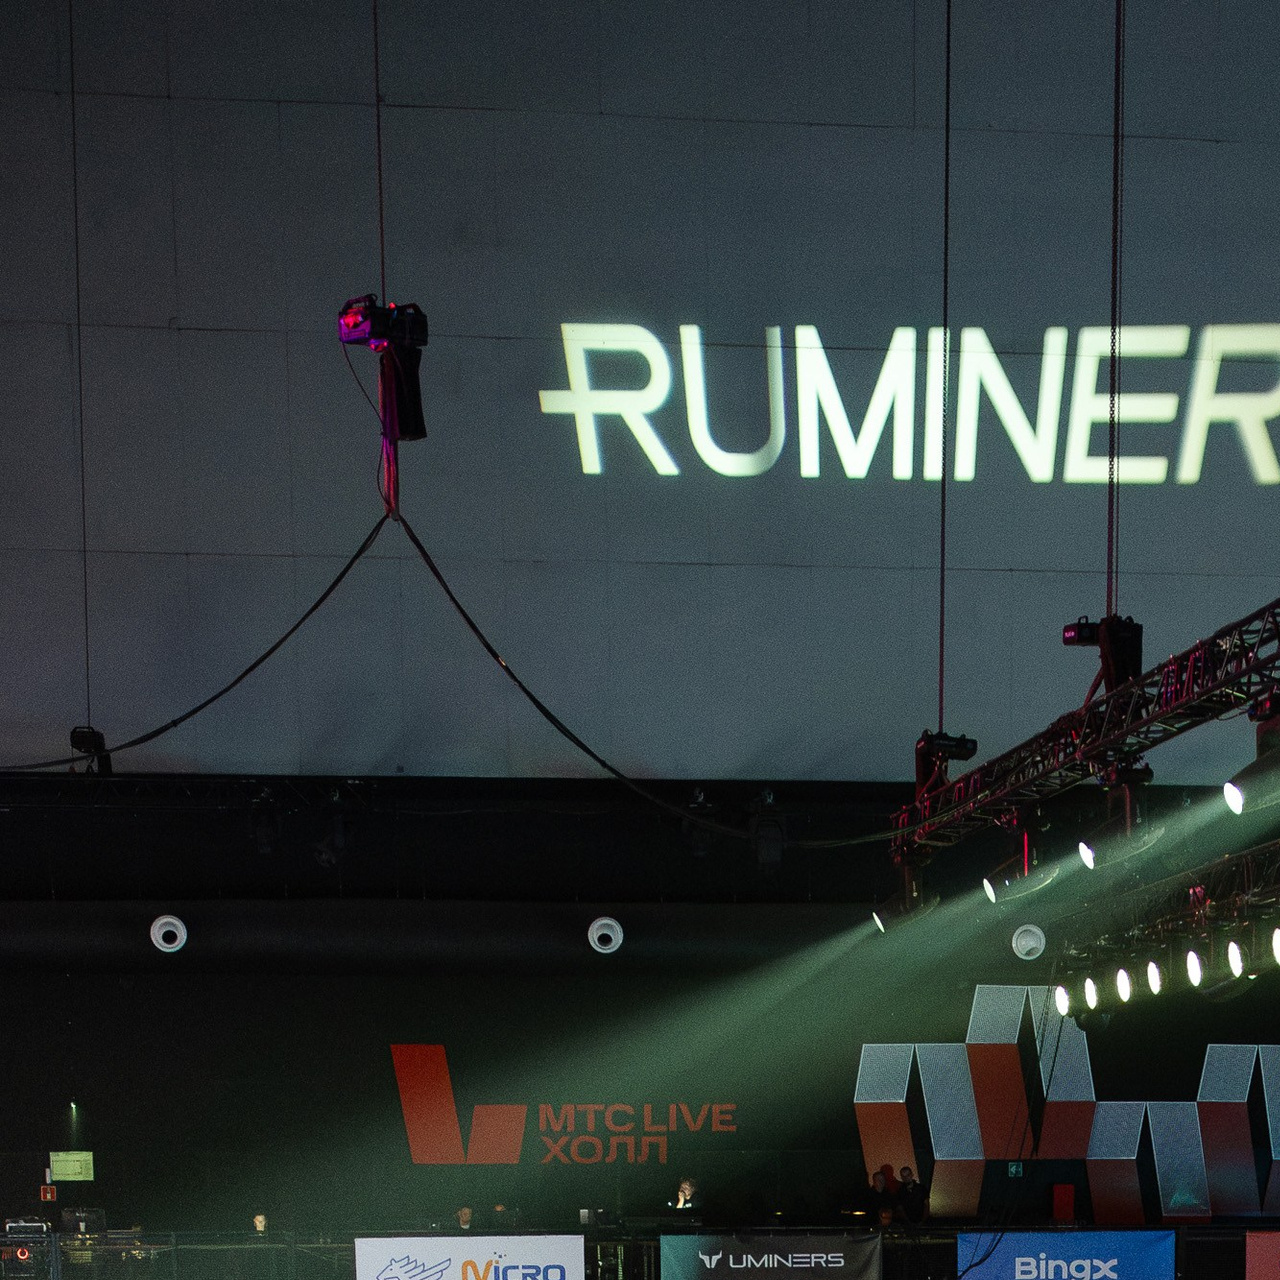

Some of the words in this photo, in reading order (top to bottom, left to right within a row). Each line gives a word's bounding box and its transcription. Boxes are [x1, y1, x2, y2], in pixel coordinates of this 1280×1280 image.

[644, 1103, 738, 1132] LIVE
[541, 1135, 668, 1164] ХОЛЛ
[729, 1253, 845, 1268] UMINERS
